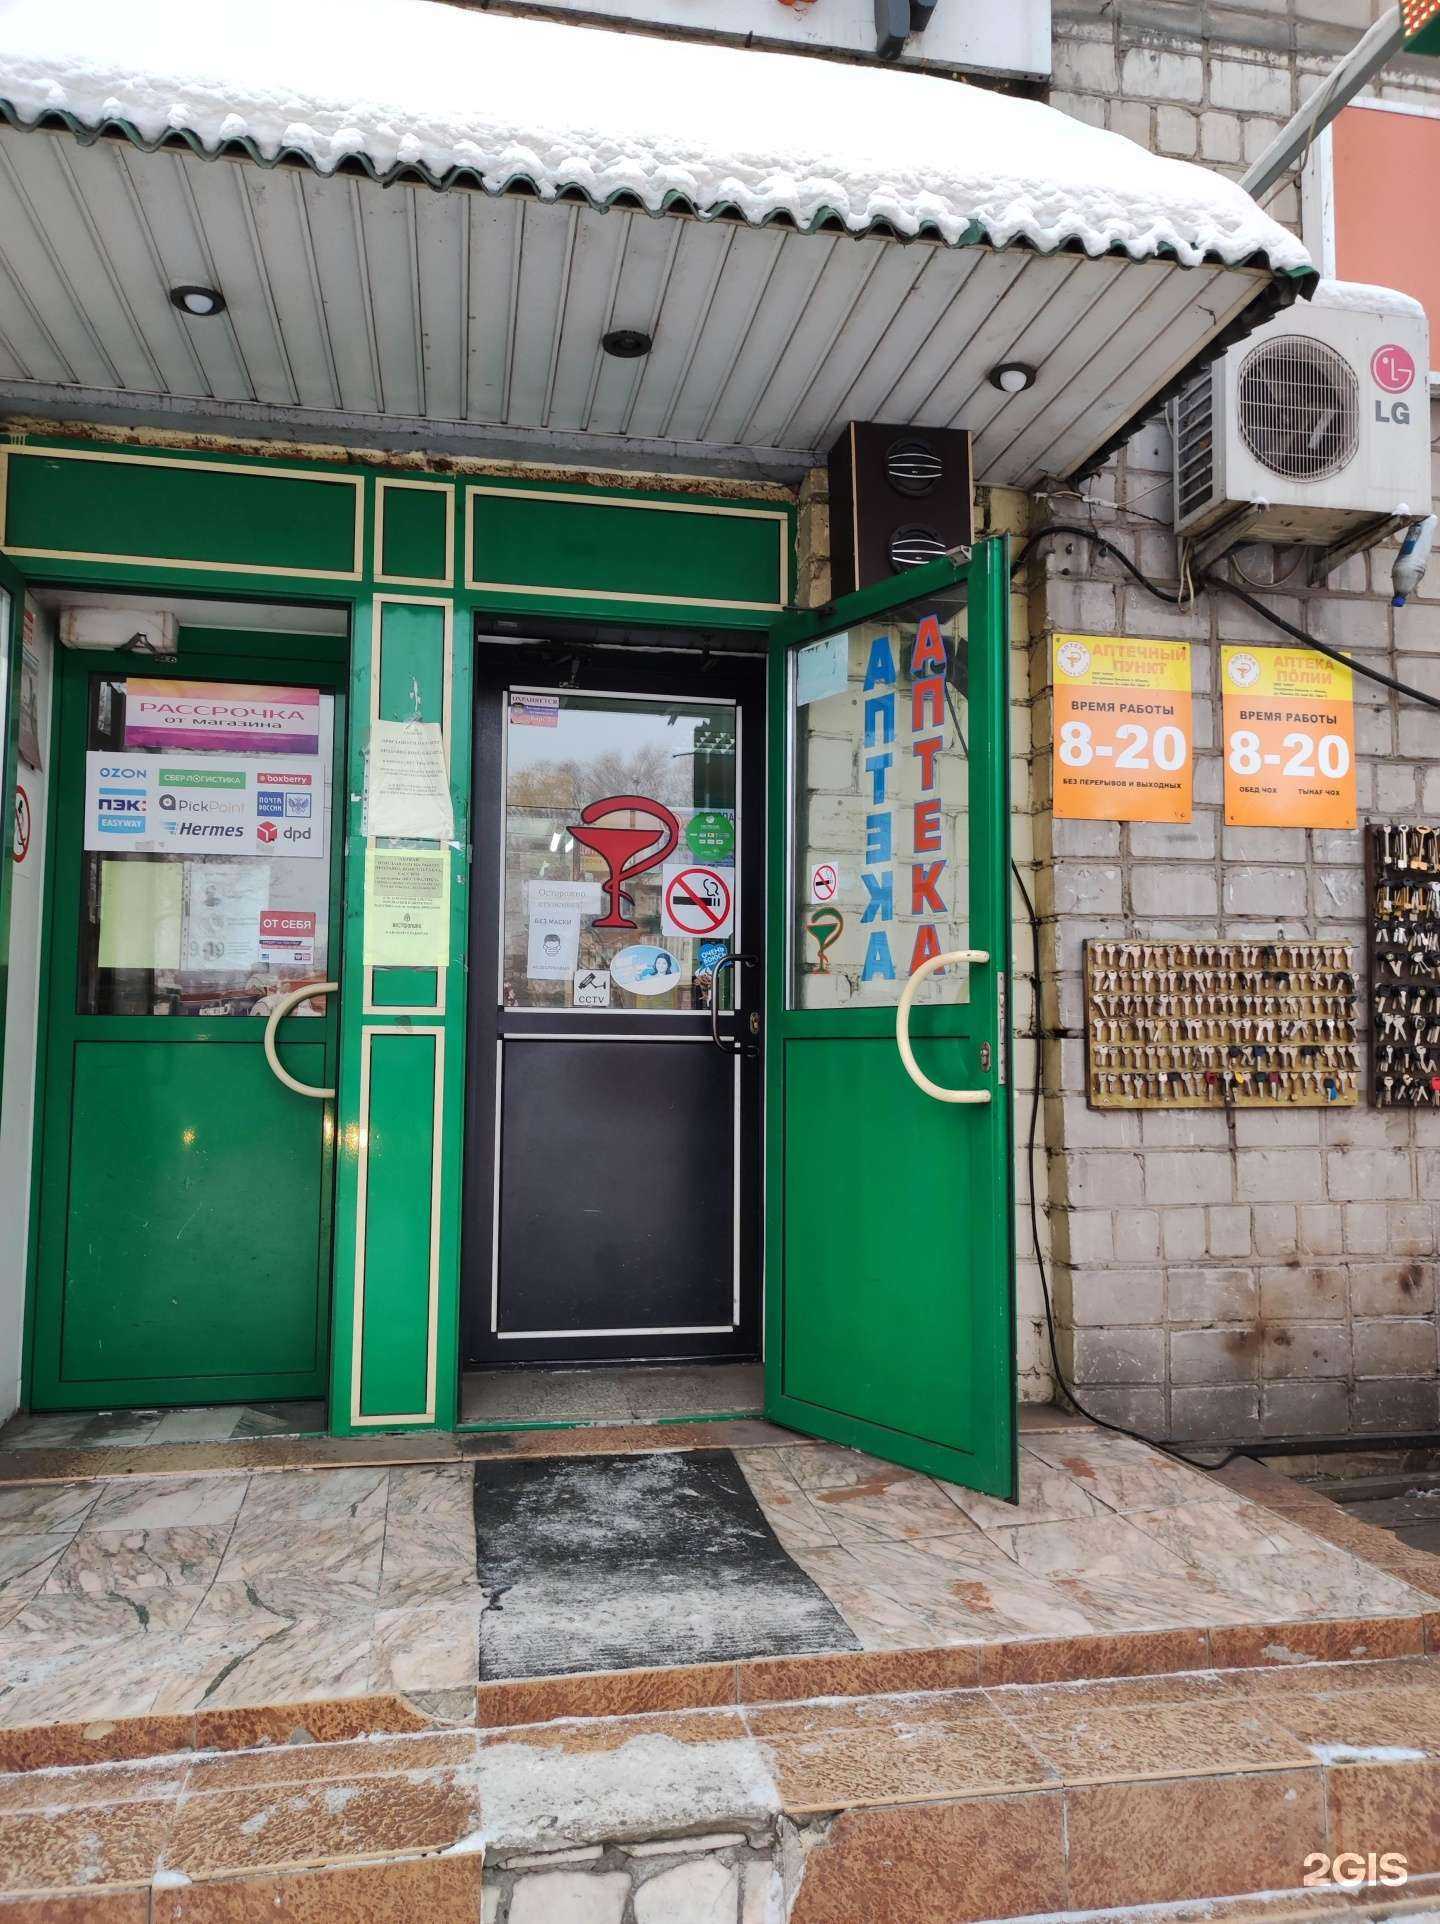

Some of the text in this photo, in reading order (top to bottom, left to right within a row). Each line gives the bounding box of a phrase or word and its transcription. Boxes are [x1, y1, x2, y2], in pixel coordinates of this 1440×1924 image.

[1375, 400, 1410, 424] LG
[1091, 643, 1187, 660] АПТЕЧНЫЙ
[1113, 661, 1168, 674] ПУНКТ
[1273, 655, 1335, 670] АПТЕКА
[140, 702, 305, 720] РАССРОЧКА
[1071, 700, 1174, 715] ВРЕМЯ РАБОТЫ
[192, 718, 282, 729] магазина
[1240, 710, 1337, 725] ВРЕМЯ РАБОТЫ
[1059, 720, 1186, 771] 8-20
[1229, 730, 1350, 778] 8-20
[100, 767, 146, 778] OZON
[267, 775, 307, 785] boxberry
[1079, 778, 1127, 787] ПЕРЕРЫВОВ
[1136, 781, 1182, 789] ВЫХОДНЫХ
[909, 614, 949, 976] АПТЕКА
[179, 800, 245, 813] PickPoint
[179, 822, 244, 837] Hermes
[284, 826, 311, 842] dpd
[263, 918, 278, 929] ОТ
[281, 919, 311, 929] СЕБЯ
[578, 995, 605, 1004] CCTV
